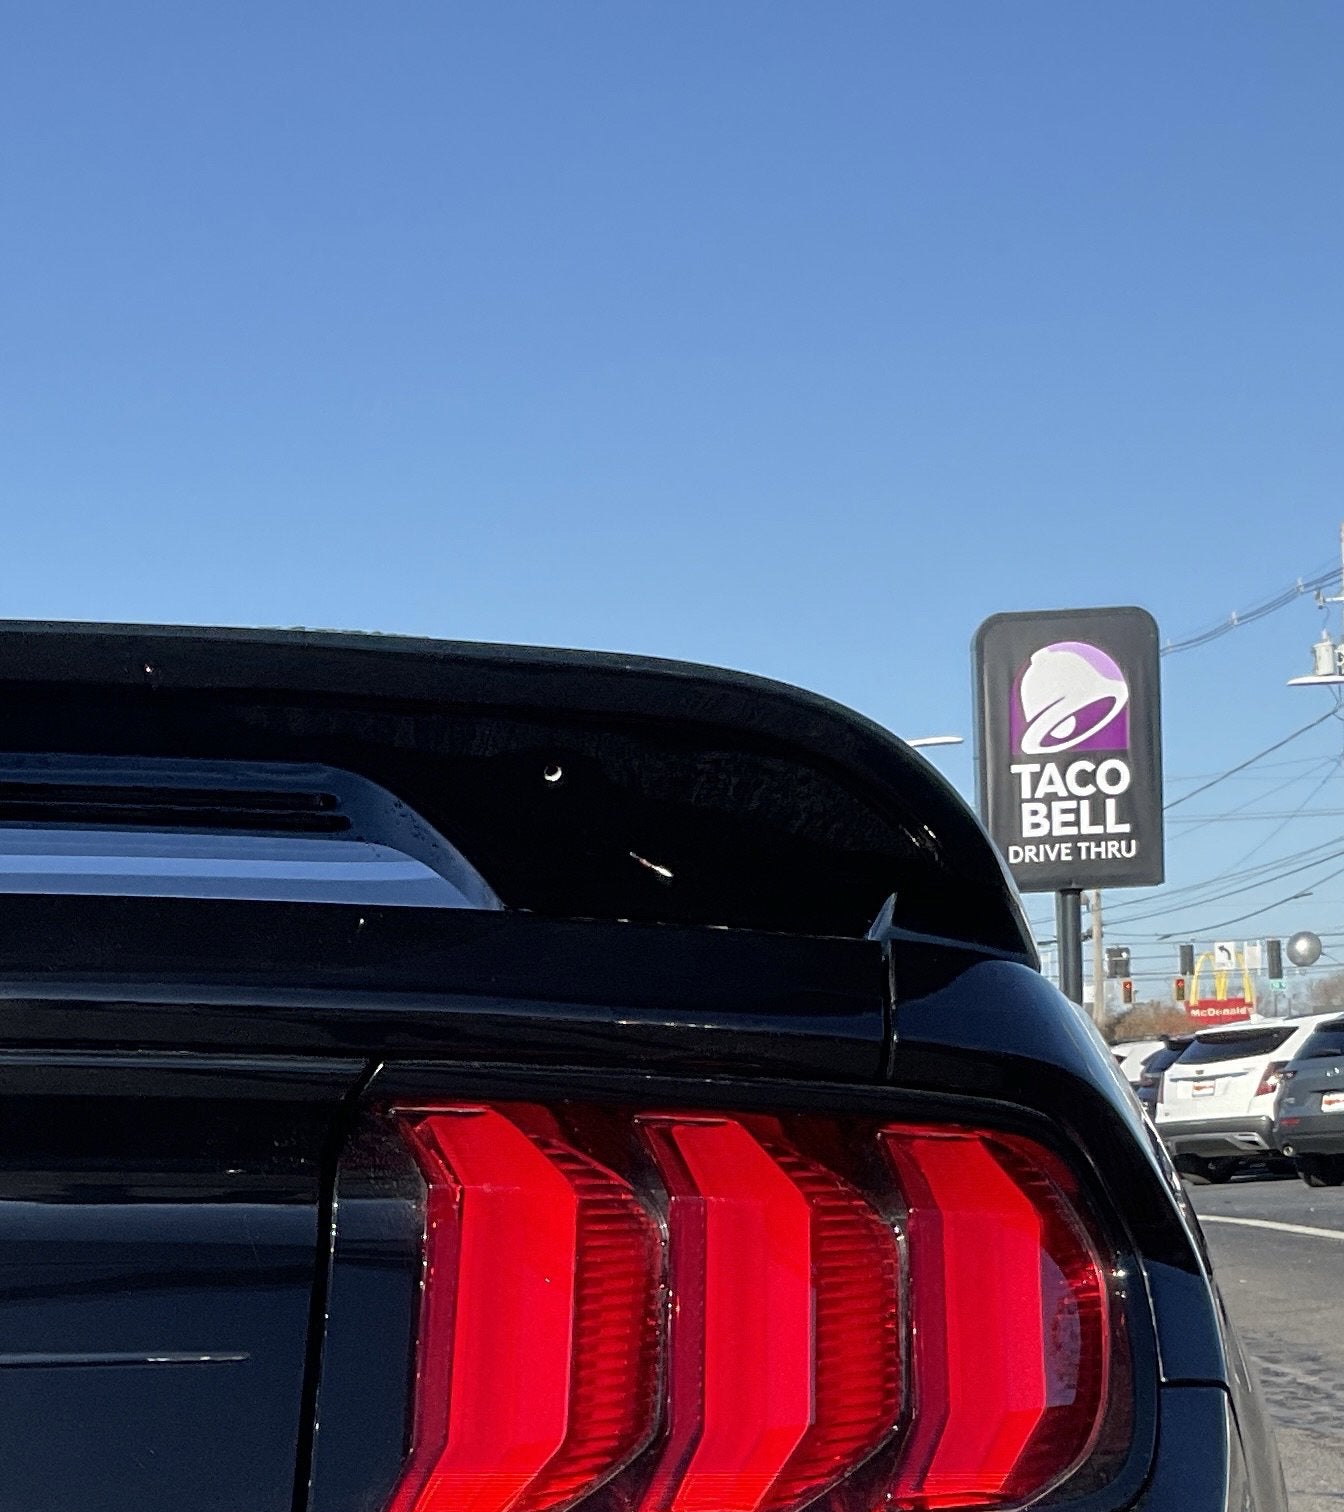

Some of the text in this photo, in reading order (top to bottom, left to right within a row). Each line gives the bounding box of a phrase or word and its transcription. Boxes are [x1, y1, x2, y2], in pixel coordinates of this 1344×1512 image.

[1010, 758, 1131, 799] TACO
[1021, 798, 1131, 838] BELL
[1008, 839, 1136, 864] DRIVE THRU
